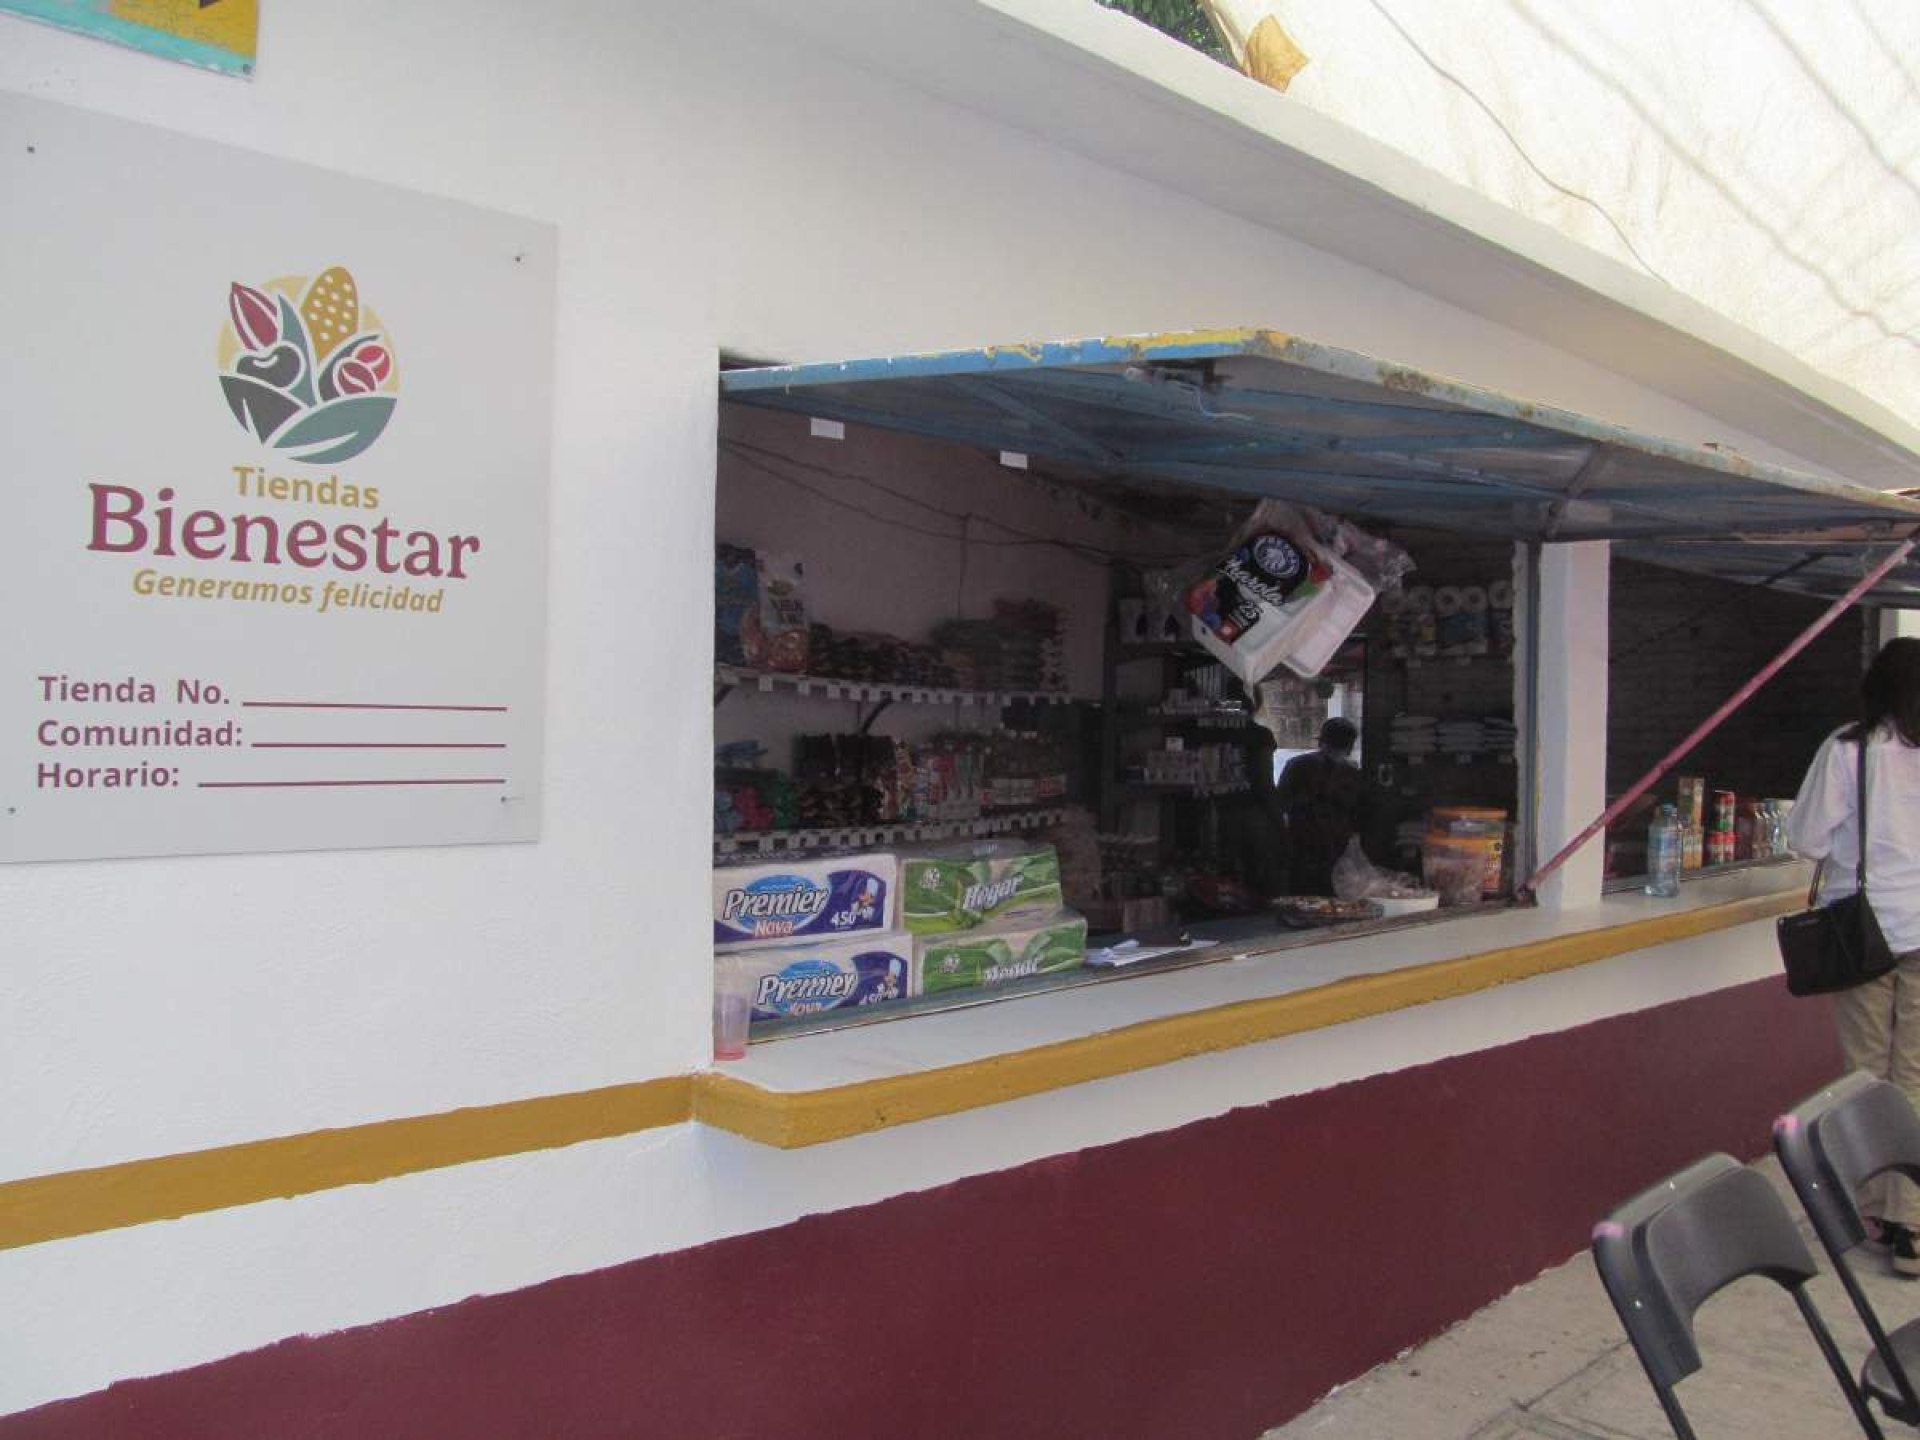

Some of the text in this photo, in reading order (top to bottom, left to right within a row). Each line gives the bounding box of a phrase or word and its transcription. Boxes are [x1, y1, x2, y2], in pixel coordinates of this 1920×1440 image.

[233, 465, 379, 510] Tiendas
[86, 482, 481, 579] Bienestar
[132, 569, 445, 613] Generamos felicidad
[38, 676, 231, 704] Tienda No.
[37, 720, 243, 746] Comunidad:
[37, 762, 180, 788] Horario:
[722, 884, 832, 921] Premier
[962, 874, 1024, 910] Hogar
[754, 919, 794, 937] Nova
[830, 911, 858, 926] 450
[757, 970, 858, 1004] Premier
